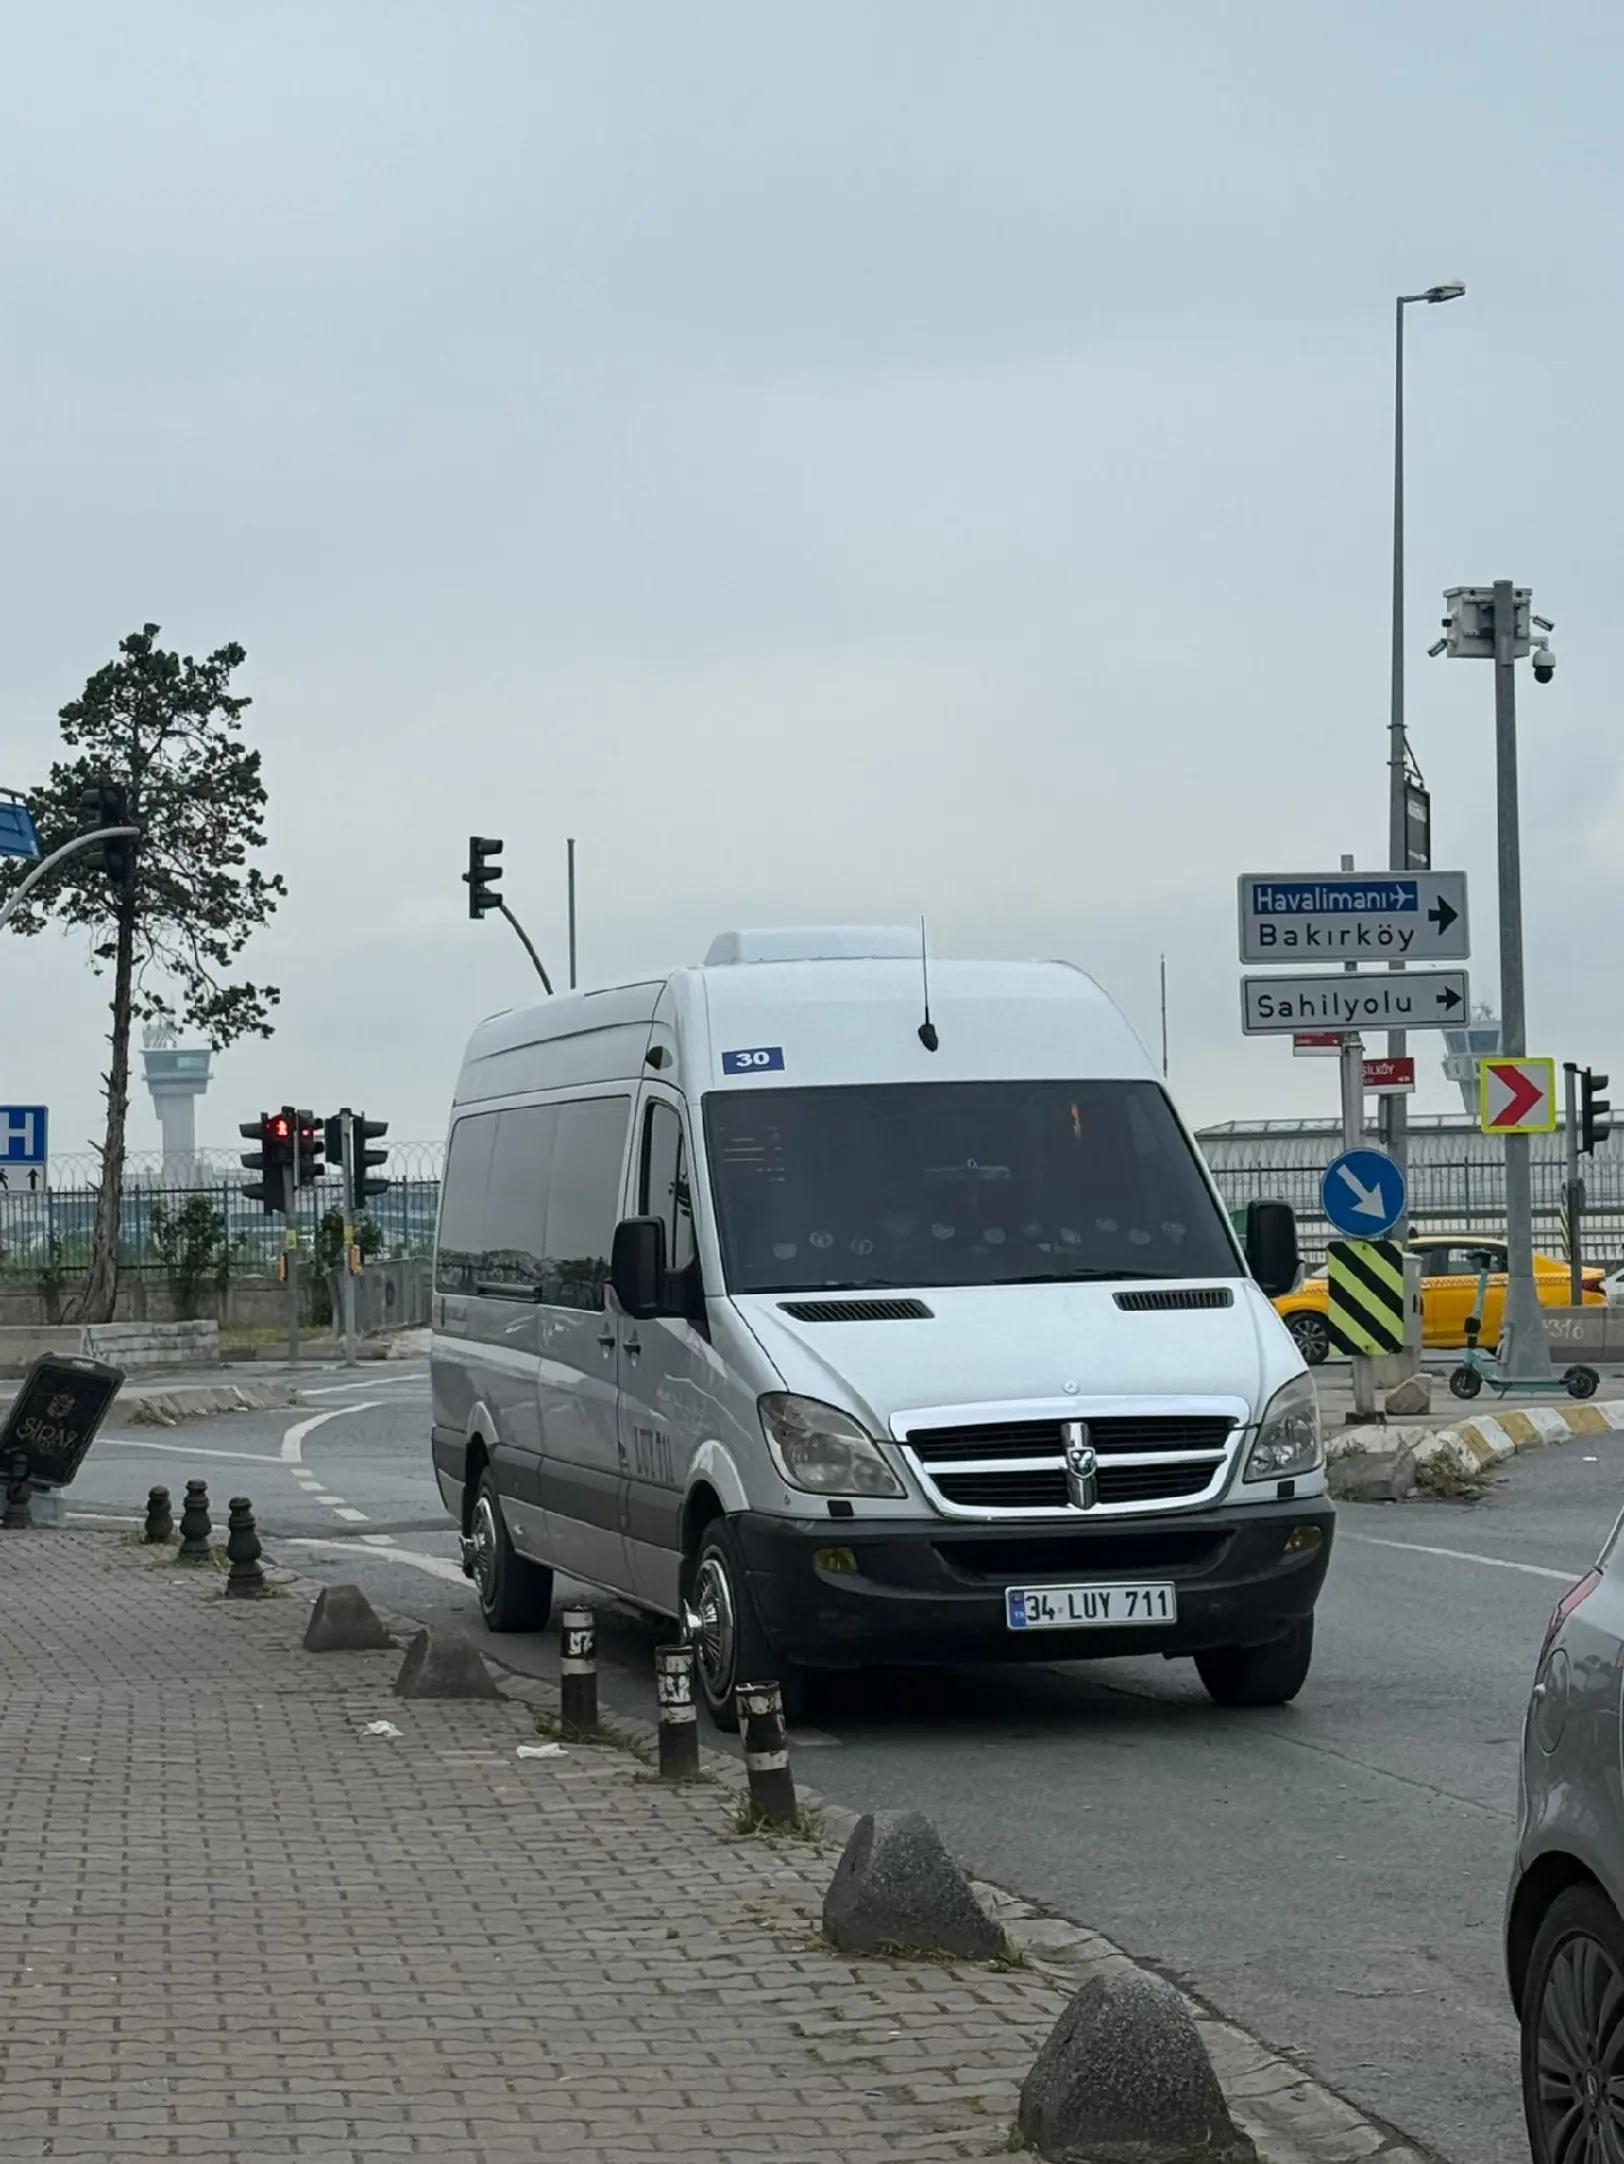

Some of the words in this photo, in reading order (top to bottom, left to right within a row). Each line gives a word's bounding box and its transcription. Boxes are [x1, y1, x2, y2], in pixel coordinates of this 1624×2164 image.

[1257, 886, 1387, 911] Havalimanı
[1259, 922, 1414, 952] Bakırköy
[1257, 990, 1412, 1022] Sahilyolu
[735, 1050, 770, 1067] 30
[1025, 1595, 1055, 1621] 34
[1068, 1592, 1110, 1619] LUY
[1125, 1590, 1168, 1617] 711
